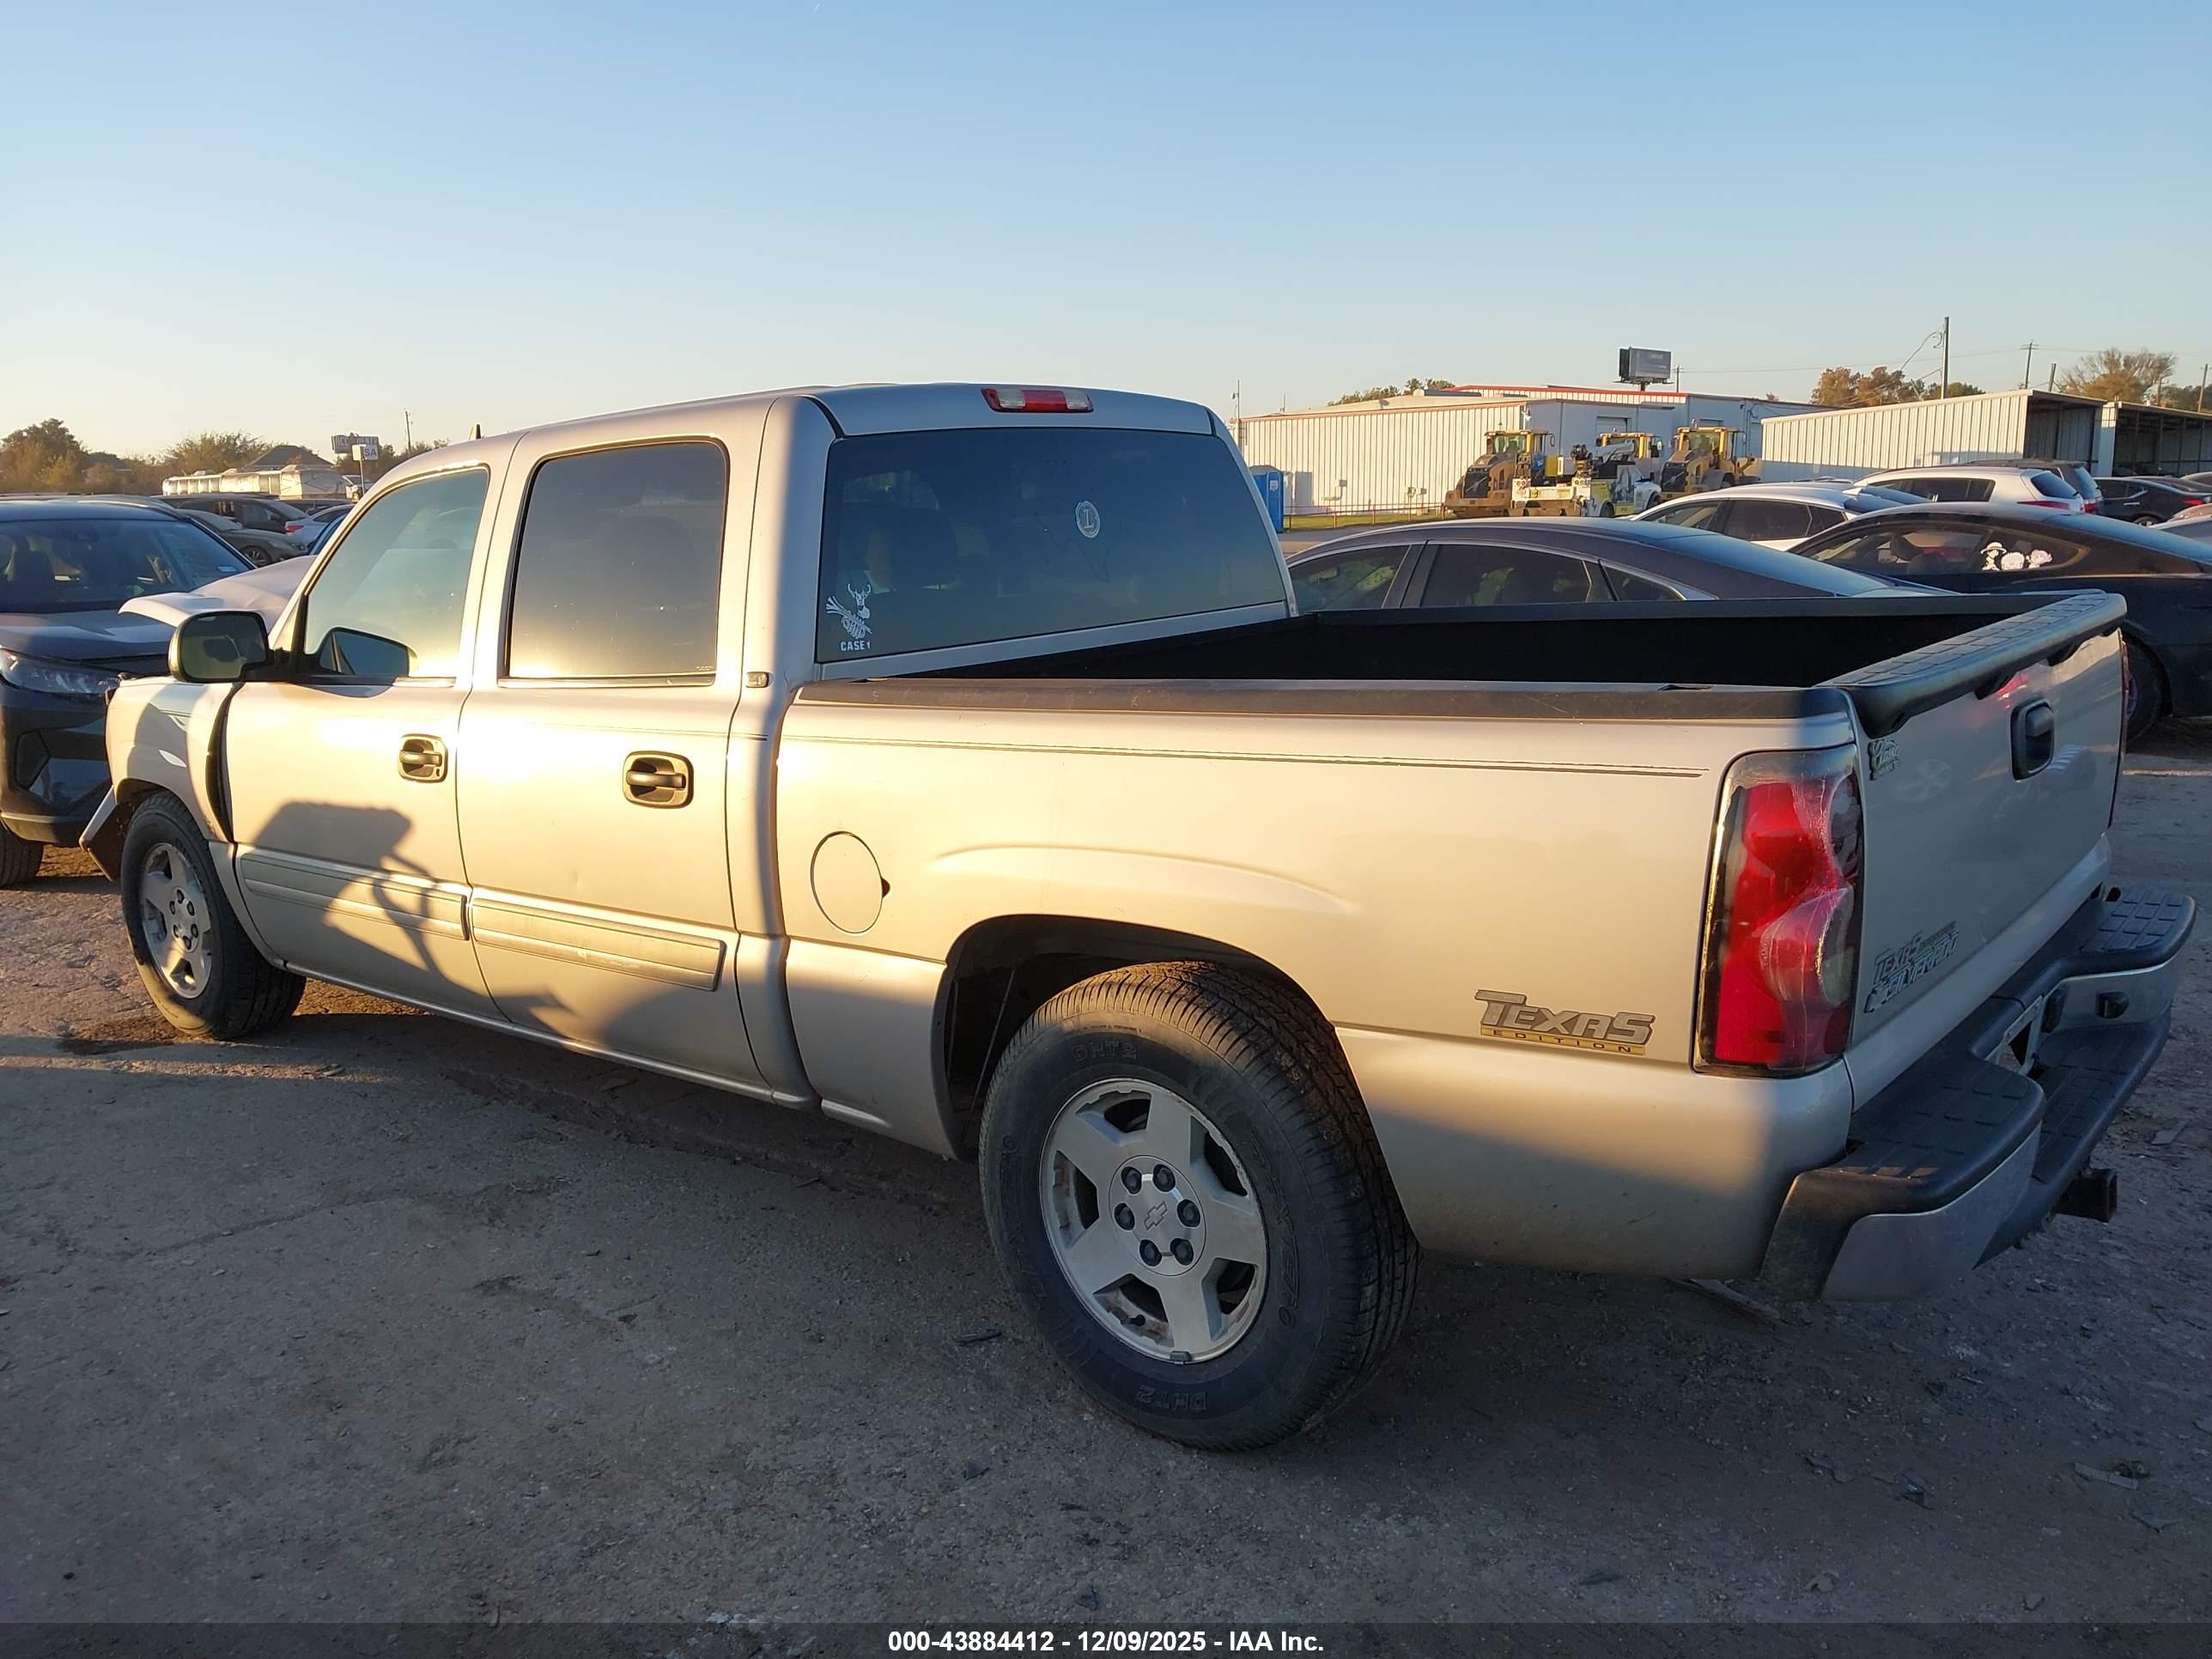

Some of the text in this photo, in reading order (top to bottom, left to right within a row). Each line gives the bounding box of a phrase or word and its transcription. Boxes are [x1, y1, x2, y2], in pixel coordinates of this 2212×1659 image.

[840, 640, 866, 652] CASE
[1474, 989, 1656, 1045] TEXAS
[1071, 1040, 1140, 1063] DHT2
[1492, 1030, 1632, 1054] EDITION
